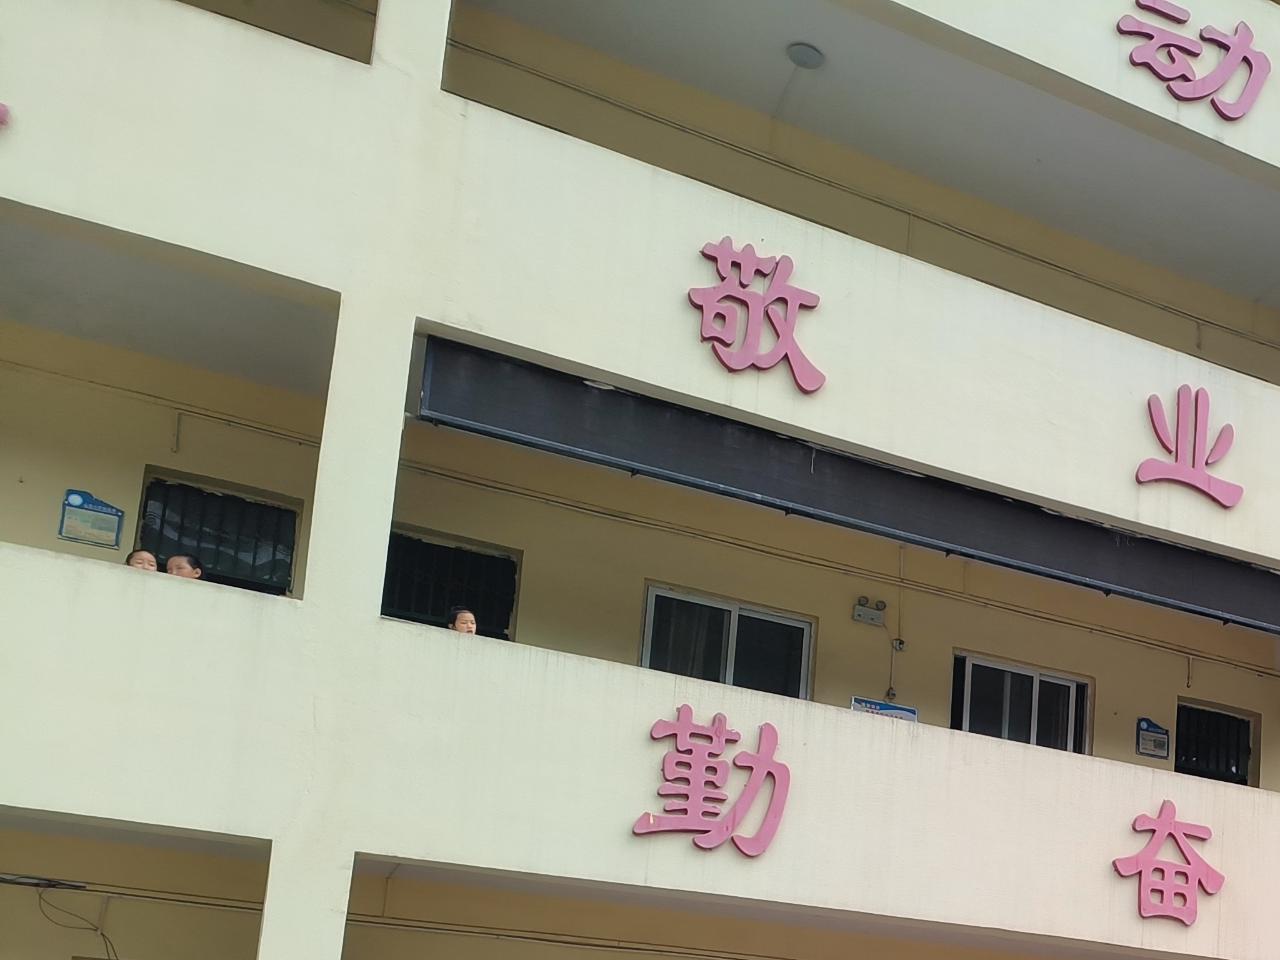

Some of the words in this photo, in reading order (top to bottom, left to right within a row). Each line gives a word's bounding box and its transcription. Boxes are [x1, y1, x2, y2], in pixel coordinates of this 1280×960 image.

[1117, 0, 1272, 122] 动
[688, 238, 826, 395] 敬
[1135, 386, 1244, 510] 业
[634, 704, 792, 858] 勤
[1112, 800, 1224, 927] 奋
